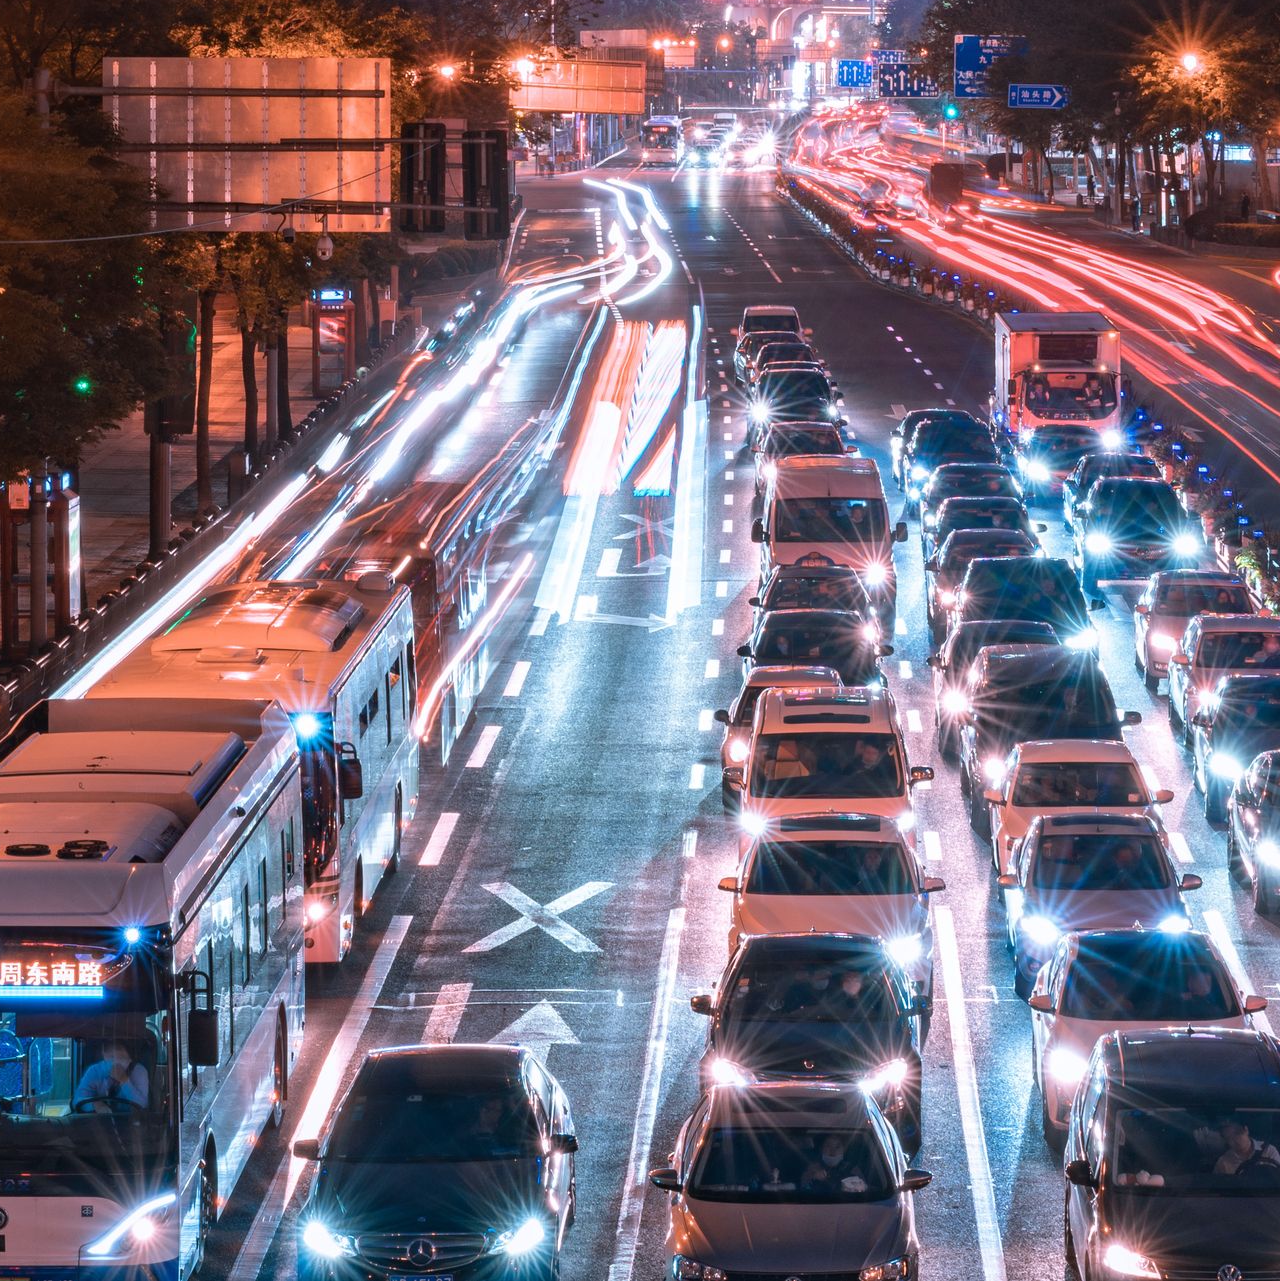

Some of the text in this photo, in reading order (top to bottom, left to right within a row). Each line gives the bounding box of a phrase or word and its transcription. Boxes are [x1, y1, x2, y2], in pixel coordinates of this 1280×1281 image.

[1021, 90, 1052, 99] 汕头路
[0, 961, 103, 986] 周东南路
